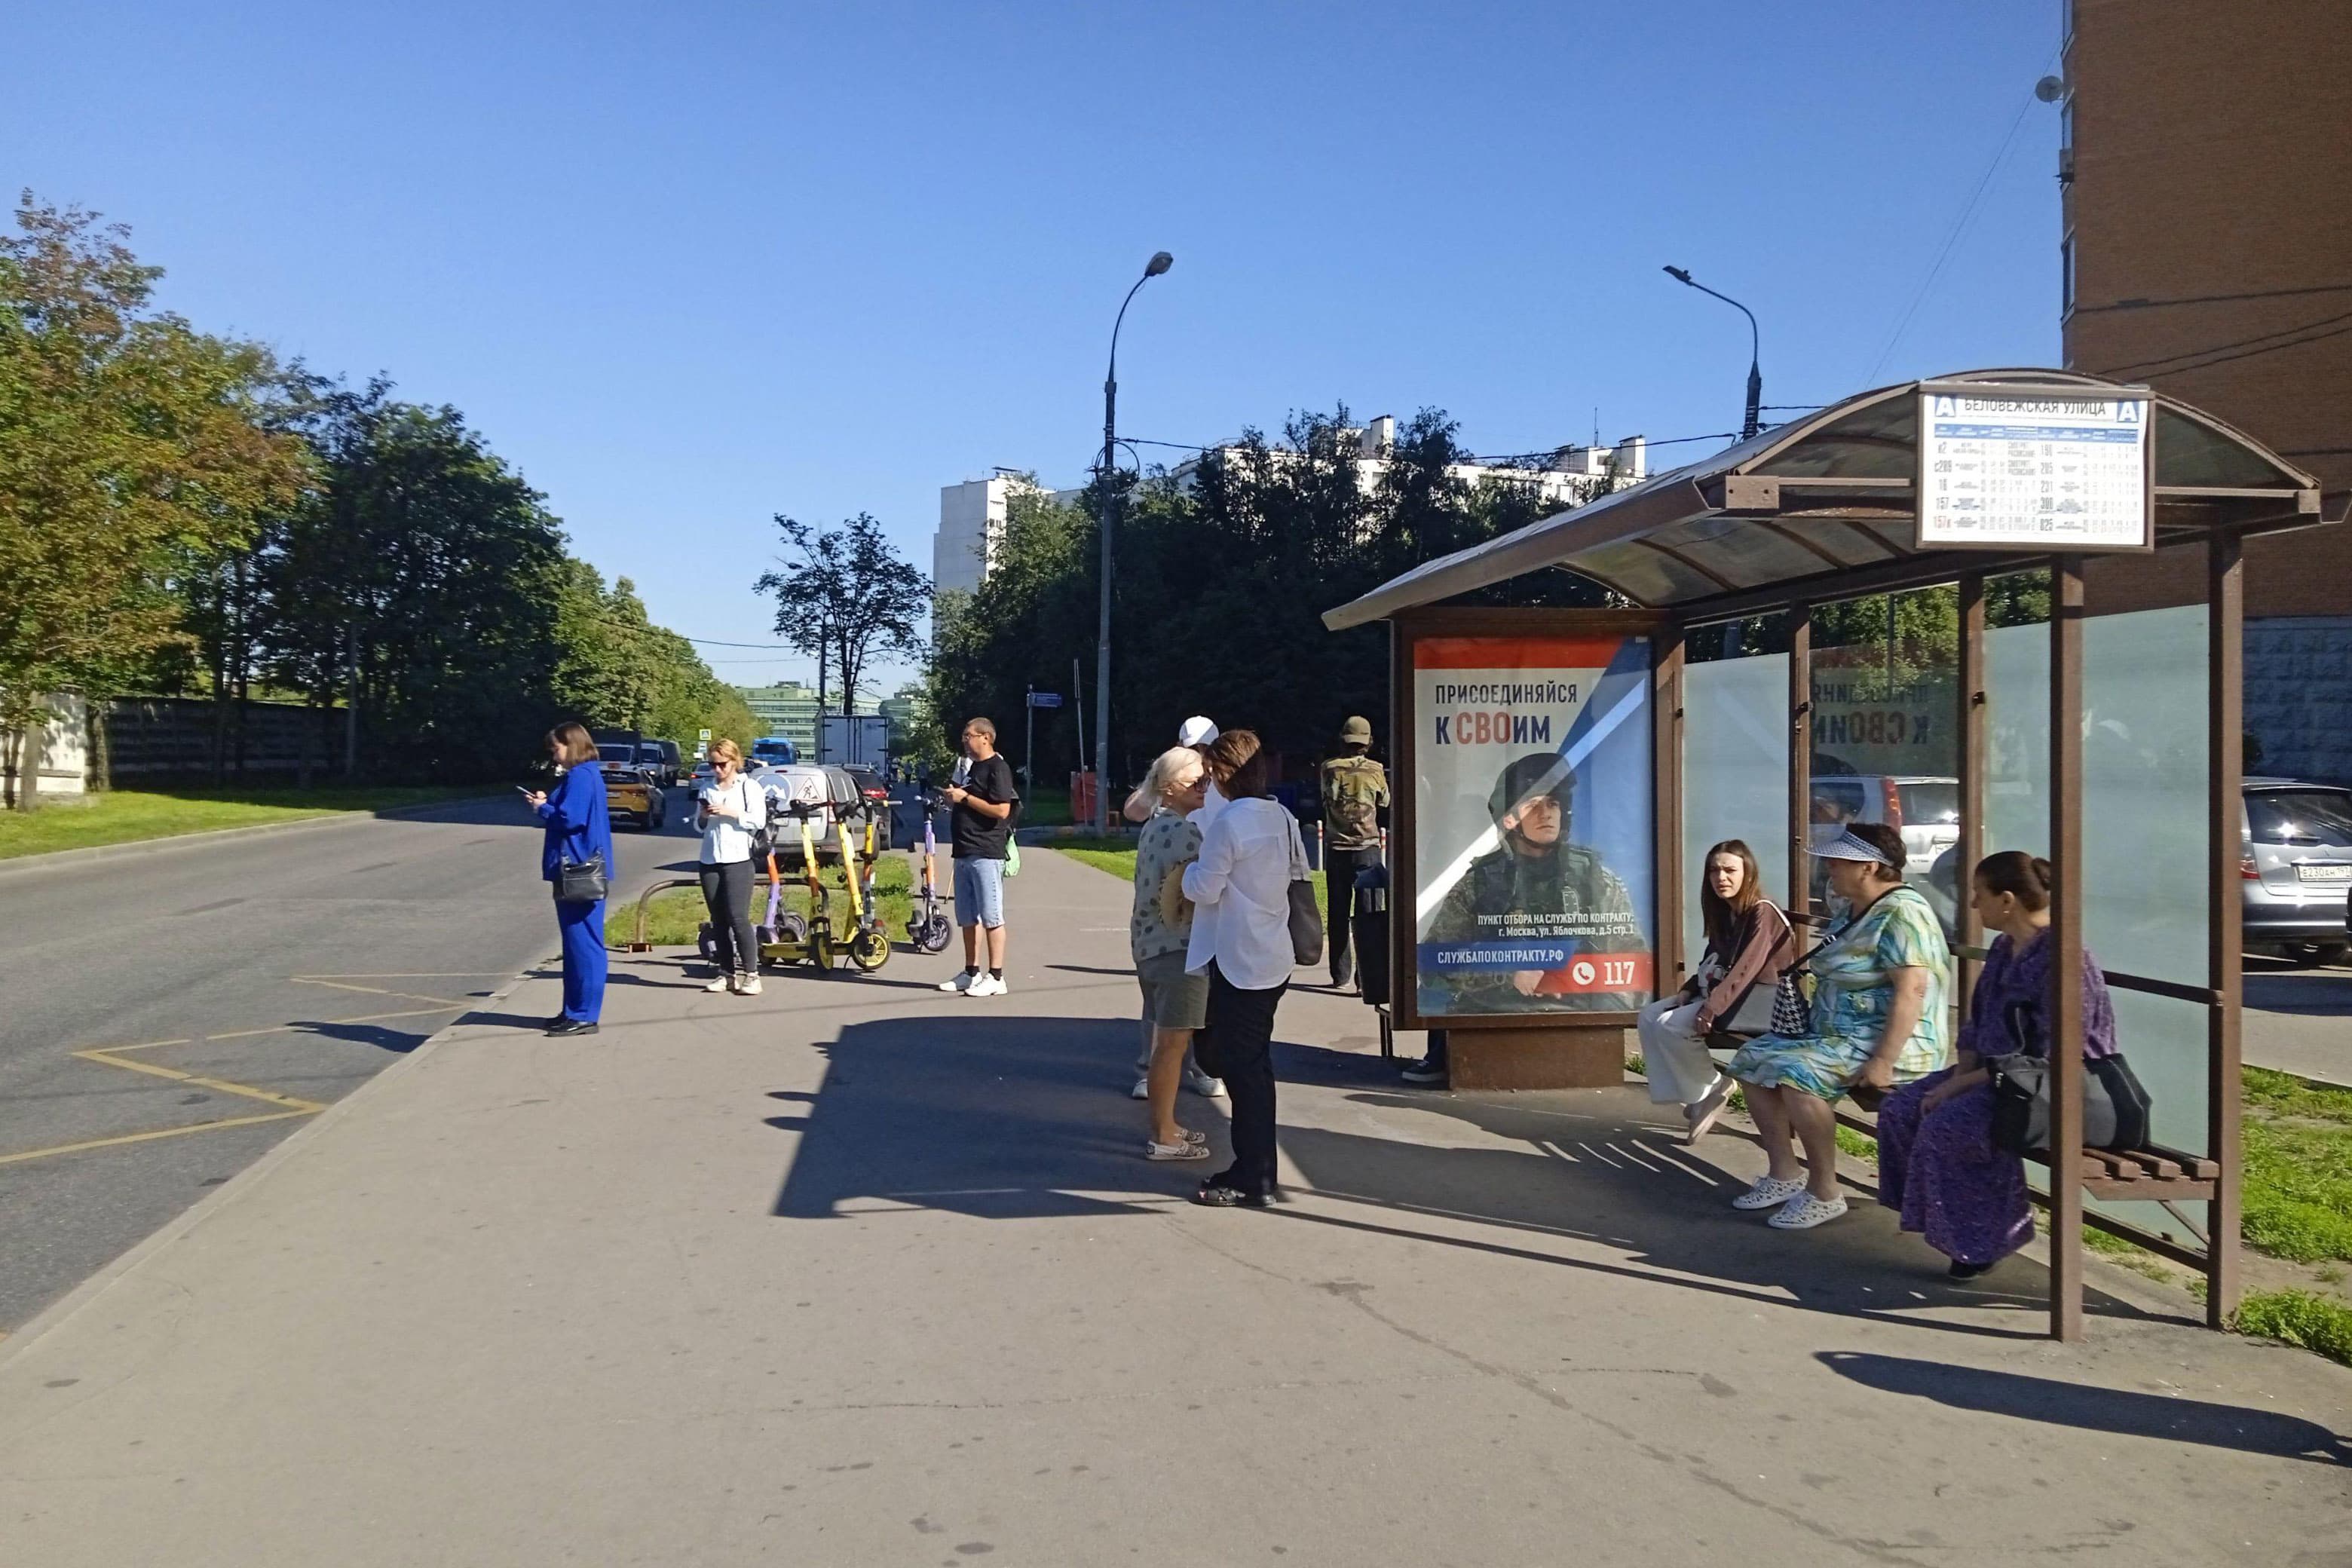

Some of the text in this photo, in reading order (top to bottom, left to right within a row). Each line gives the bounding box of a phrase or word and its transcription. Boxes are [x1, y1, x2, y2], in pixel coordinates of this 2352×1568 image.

[1965, 397, 2105, 416] БЕЛОВЕЖСКАЯ УЛИЦА
[1435, 680, 1577, 706] ПРИСОЕДИНЯЙСЯ
[1435, 712, 1550, 745] К СВОИМ
[1478, 912, 1634, 926] ПУНКТ ОТБОРА НА СЛУЖБУ ПО КОНТРАКТУ:
[1499, 928, 1505, 937] г.
[1506, 927, 1539, 938] Москва,
[1539, 927, 1552, 938] ул.
[1553, 926, 1598, 936] Яблочкова,
[1438, 949, 1563, 964] СЛУЖБАПОКОНТРАКТУ.РФ
[1604, 961, 1634, 985] 117
